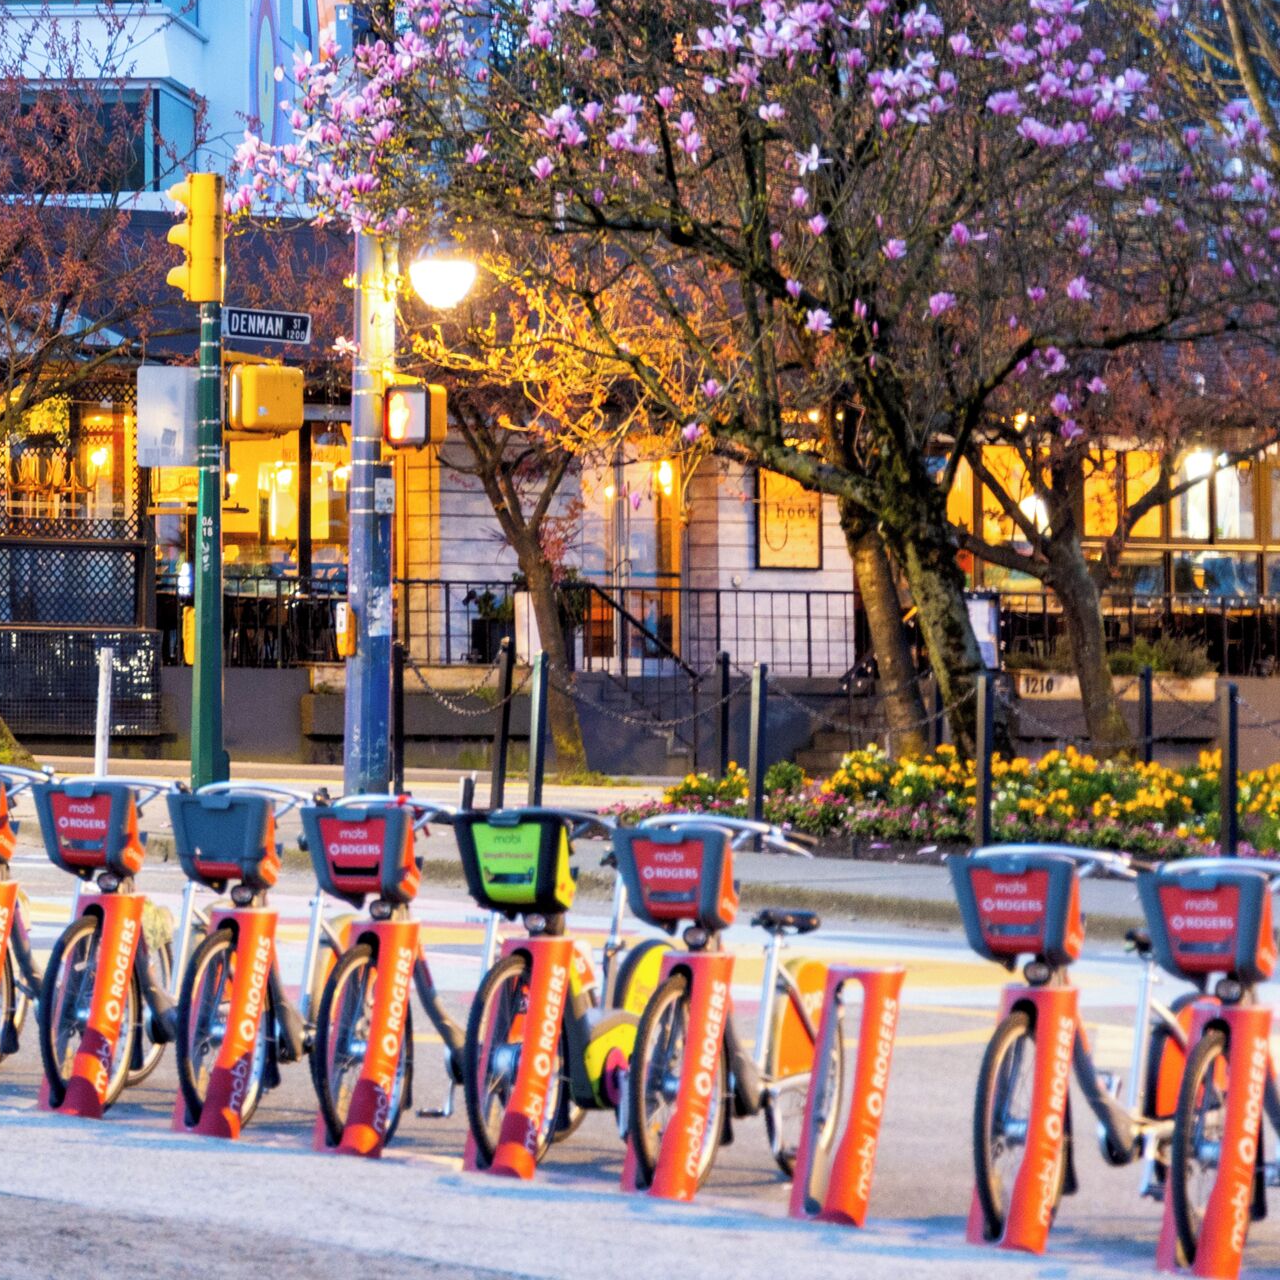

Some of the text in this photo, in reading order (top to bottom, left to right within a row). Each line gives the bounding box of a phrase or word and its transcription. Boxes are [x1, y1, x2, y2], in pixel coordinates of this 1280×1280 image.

[230, 313, 302, 336] DENMAN ST
[286, 330, 306, 340] 1200
[776, 502, 817, 519] hook
[202, 516, 213, 526] 06
[203, 527, 213, 537] 18
[1025, 676, 1054, 694] 1210
[68, 803, 95, 814] mobi
[70, 818, 107, 830] ROGERS
[339, 827, 368, 840] mobi
[495, 833, 521, 844] mobi
[341, 844, 381, 855] ROGERS
[655, 849, 684, 863] mobi
[656, 867, 699, 879] ROGERS
[995, 881, 1027, 894] mobi
[997, 899, 1043, 912] ROGERS
[1185, 898, 1218, 912] mobi
[1186, 916, 1234, 930] ROGERS
[111, 917, 137, 1000] ROGERS
[387, 946, 413, 1032] ROGERS
[539, 964, 567, 1052] ROGERS
[229, 935, 271, 1115] mobi ROGERS
[685, 979, 727, 1178] mobi ROGERS
[856, 996, 898, 1201] mobi ROGERS
[1037, 1015, 1074, 1227] mobi ROGERS
[1231, 1036, 1269, 1254] mobi ROGERS
